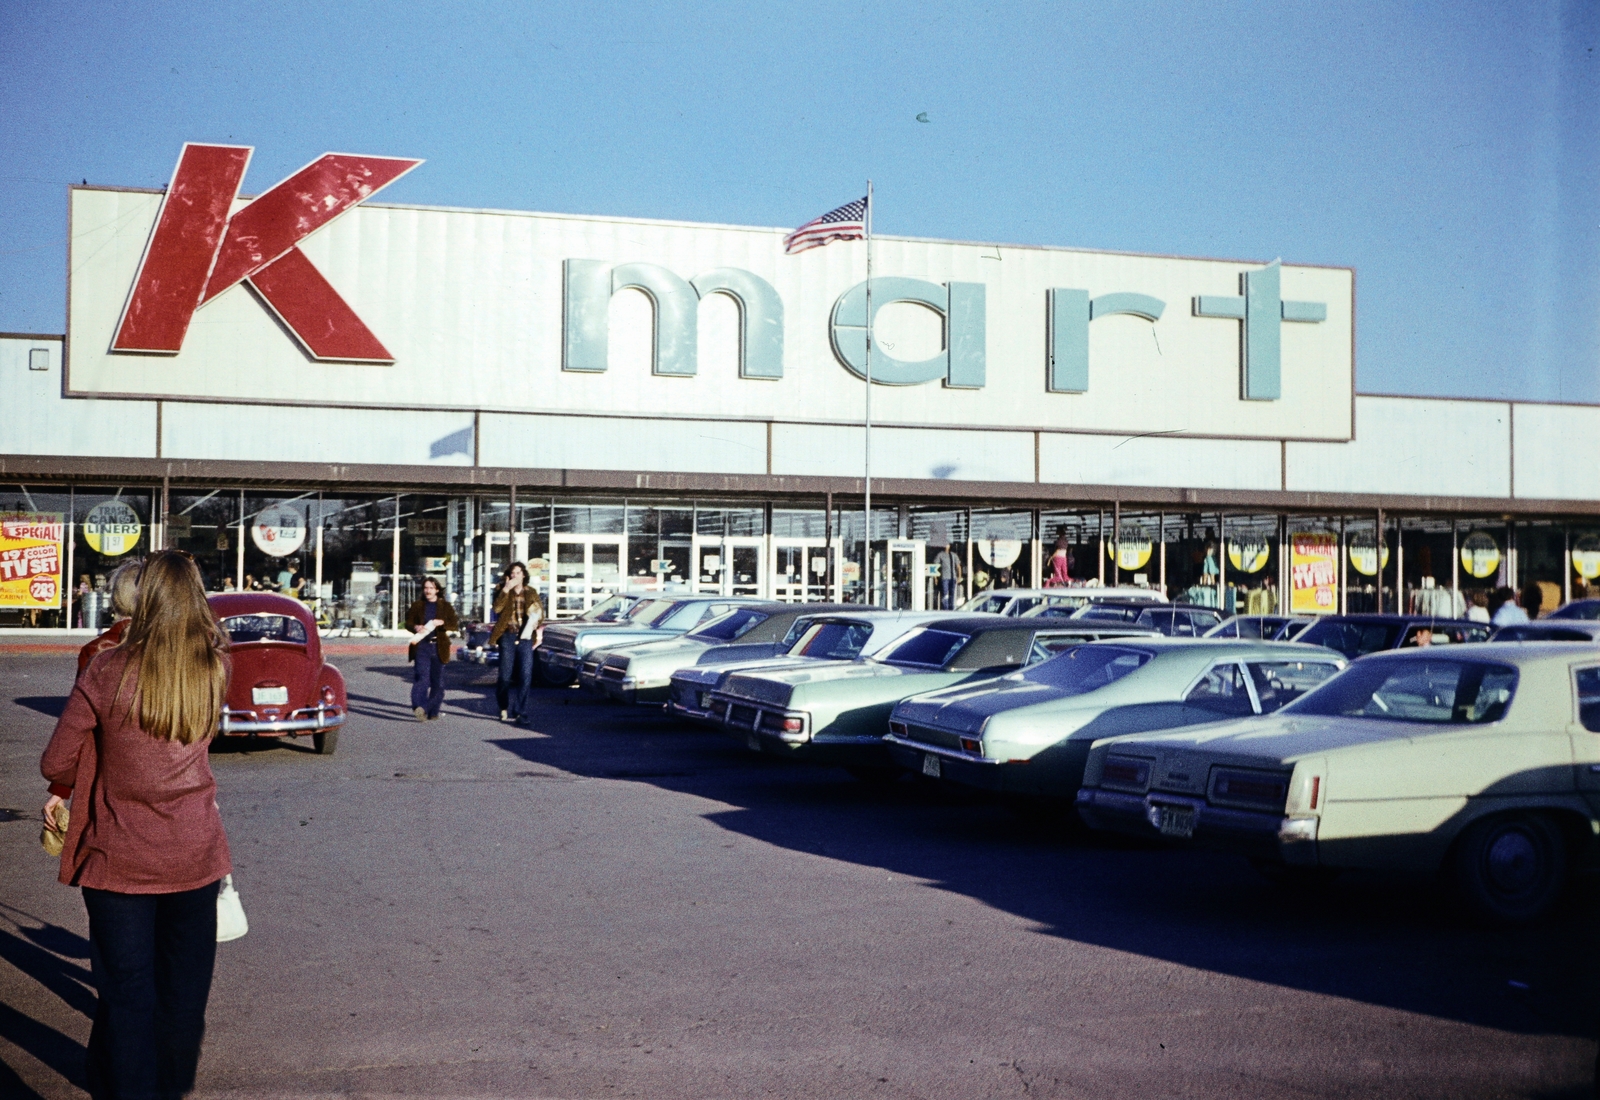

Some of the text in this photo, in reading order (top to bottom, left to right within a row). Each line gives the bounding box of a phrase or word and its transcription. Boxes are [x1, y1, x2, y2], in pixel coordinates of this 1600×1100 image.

[109, 141, 1328, 402] K mart
[87, 524, 139, 534] LINERS
[27, 548, 54, 557] COLOR
[0, 557, 58, 579] TV SET
